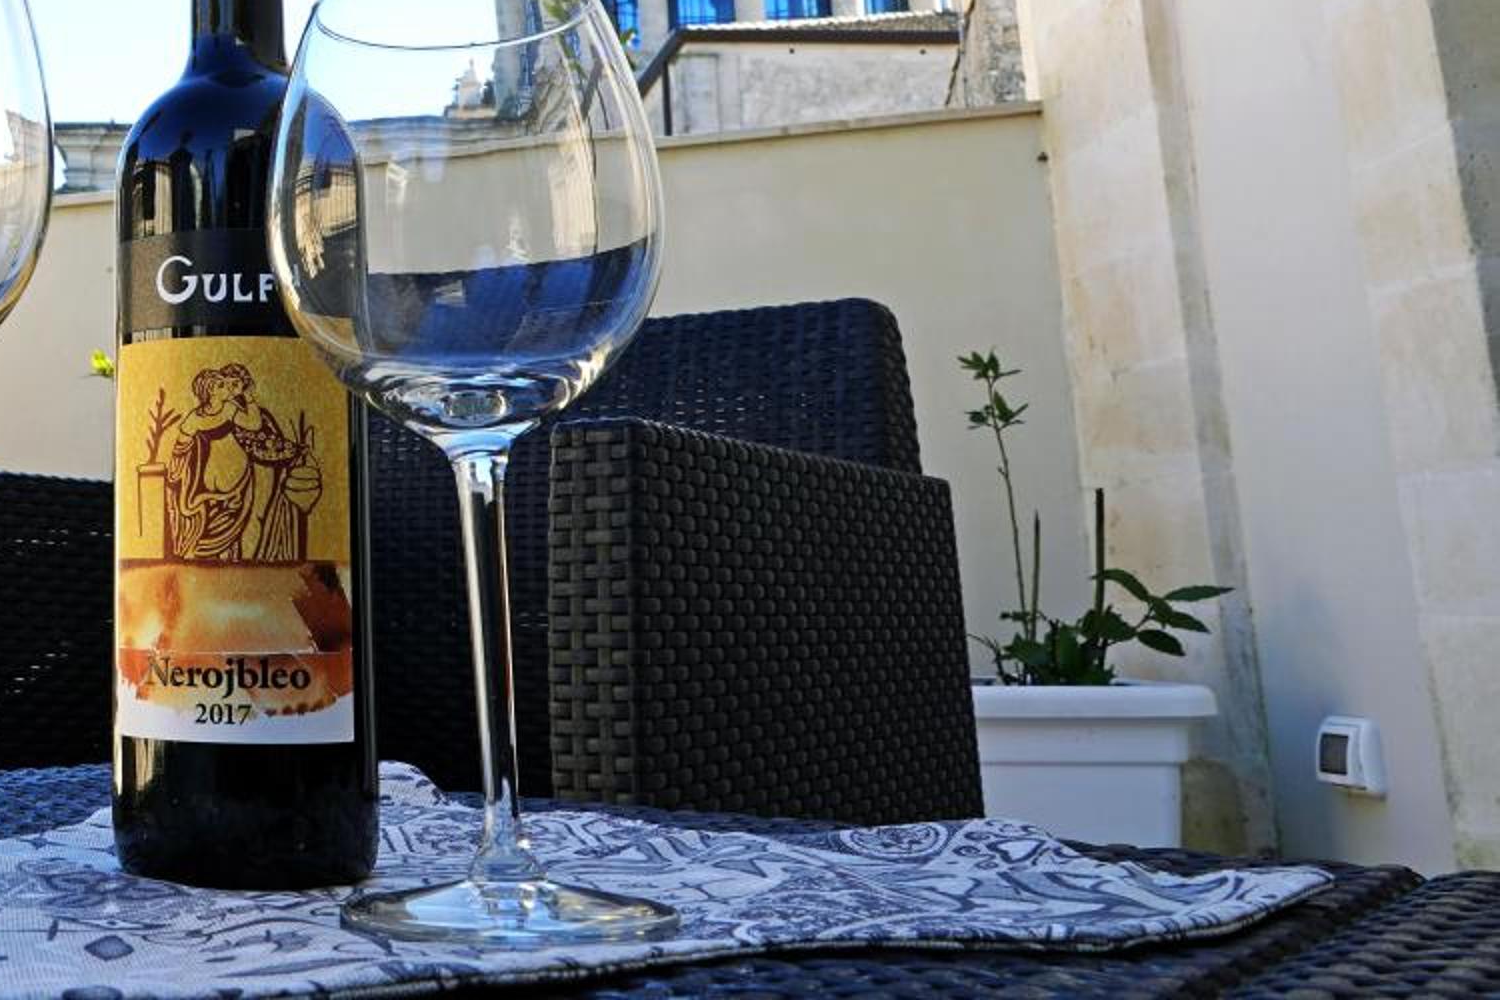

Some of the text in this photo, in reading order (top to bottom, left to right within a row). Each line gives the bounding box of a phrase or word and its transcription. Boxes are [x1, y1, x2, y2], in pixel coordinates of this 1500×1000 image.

[156, 255, 276, 304] GULF
[146, 656, 312, 698] Nerojbleo
[195, 703, 252, 725] 2017
